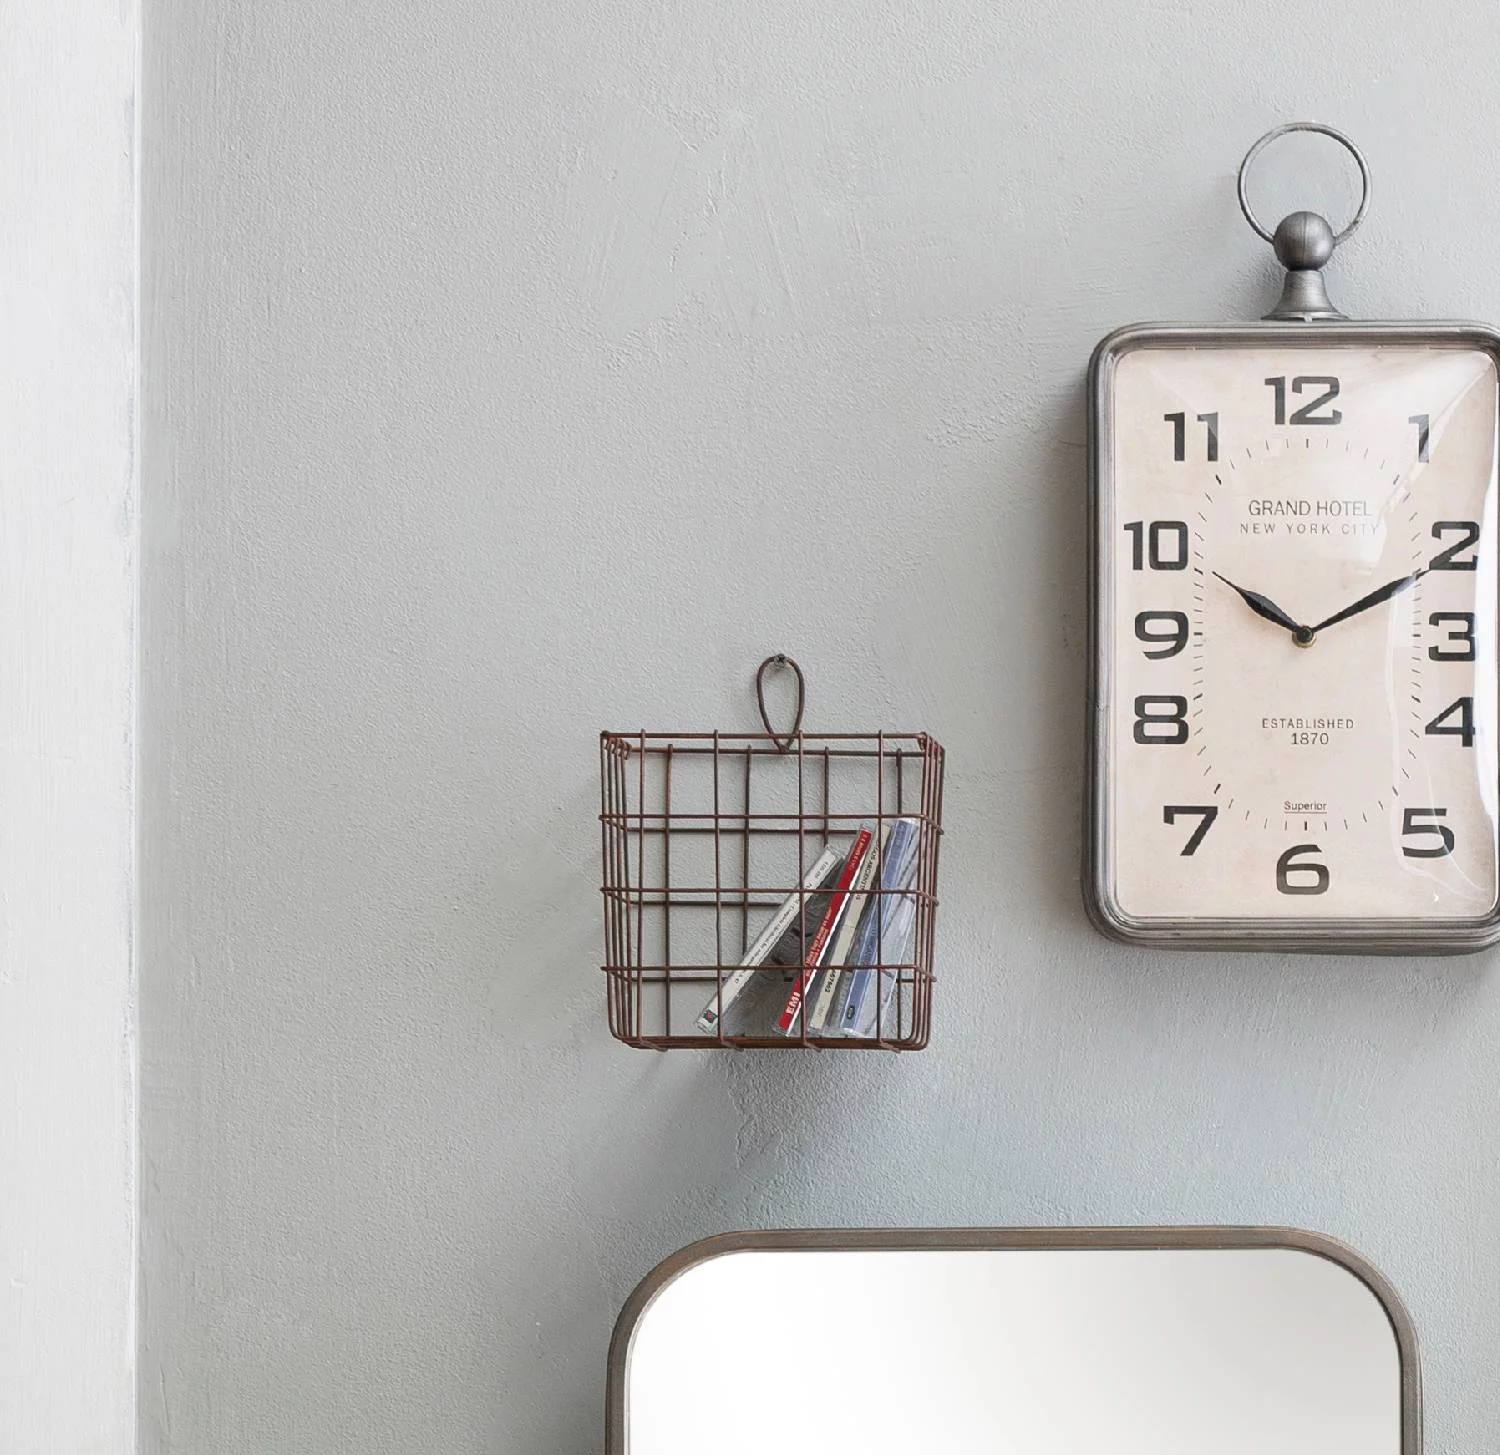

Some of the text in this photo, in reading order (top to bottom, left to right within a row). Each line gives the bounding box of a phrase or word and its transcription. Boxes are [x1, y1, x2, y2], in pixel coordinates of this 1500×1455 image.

[1265, 376, 1341, 424] 12
[1164, 412, 1218, 461] 11
[1408, 413, 1430, 463] 1
[1241, 523, 1379, 534] NEW YORK CITY
[1248, 500, 1372, 516] GRAND HOTEL
[1124, 521, 1188, 570] 10
[1428, 521, 1479, 571] 2
[1135, 611, 1188, 659] 9
[1429, 612, 1475, 661] 3
[1134, 695, 1189, 744] 8
[1262, 718, 1353, 729] ESTABLISHED
[1291, 732, 1329, 745] 1870
[1425, 697, 1475, 747] 4
[1164, 806, 1218, 856] 7
[1284, 801, 1327, 812] Superior
[1402, 808, 1454, 858] 5
[1276, 845, 1329, 895] 6
[785, 991, 801, 1015] EMI
